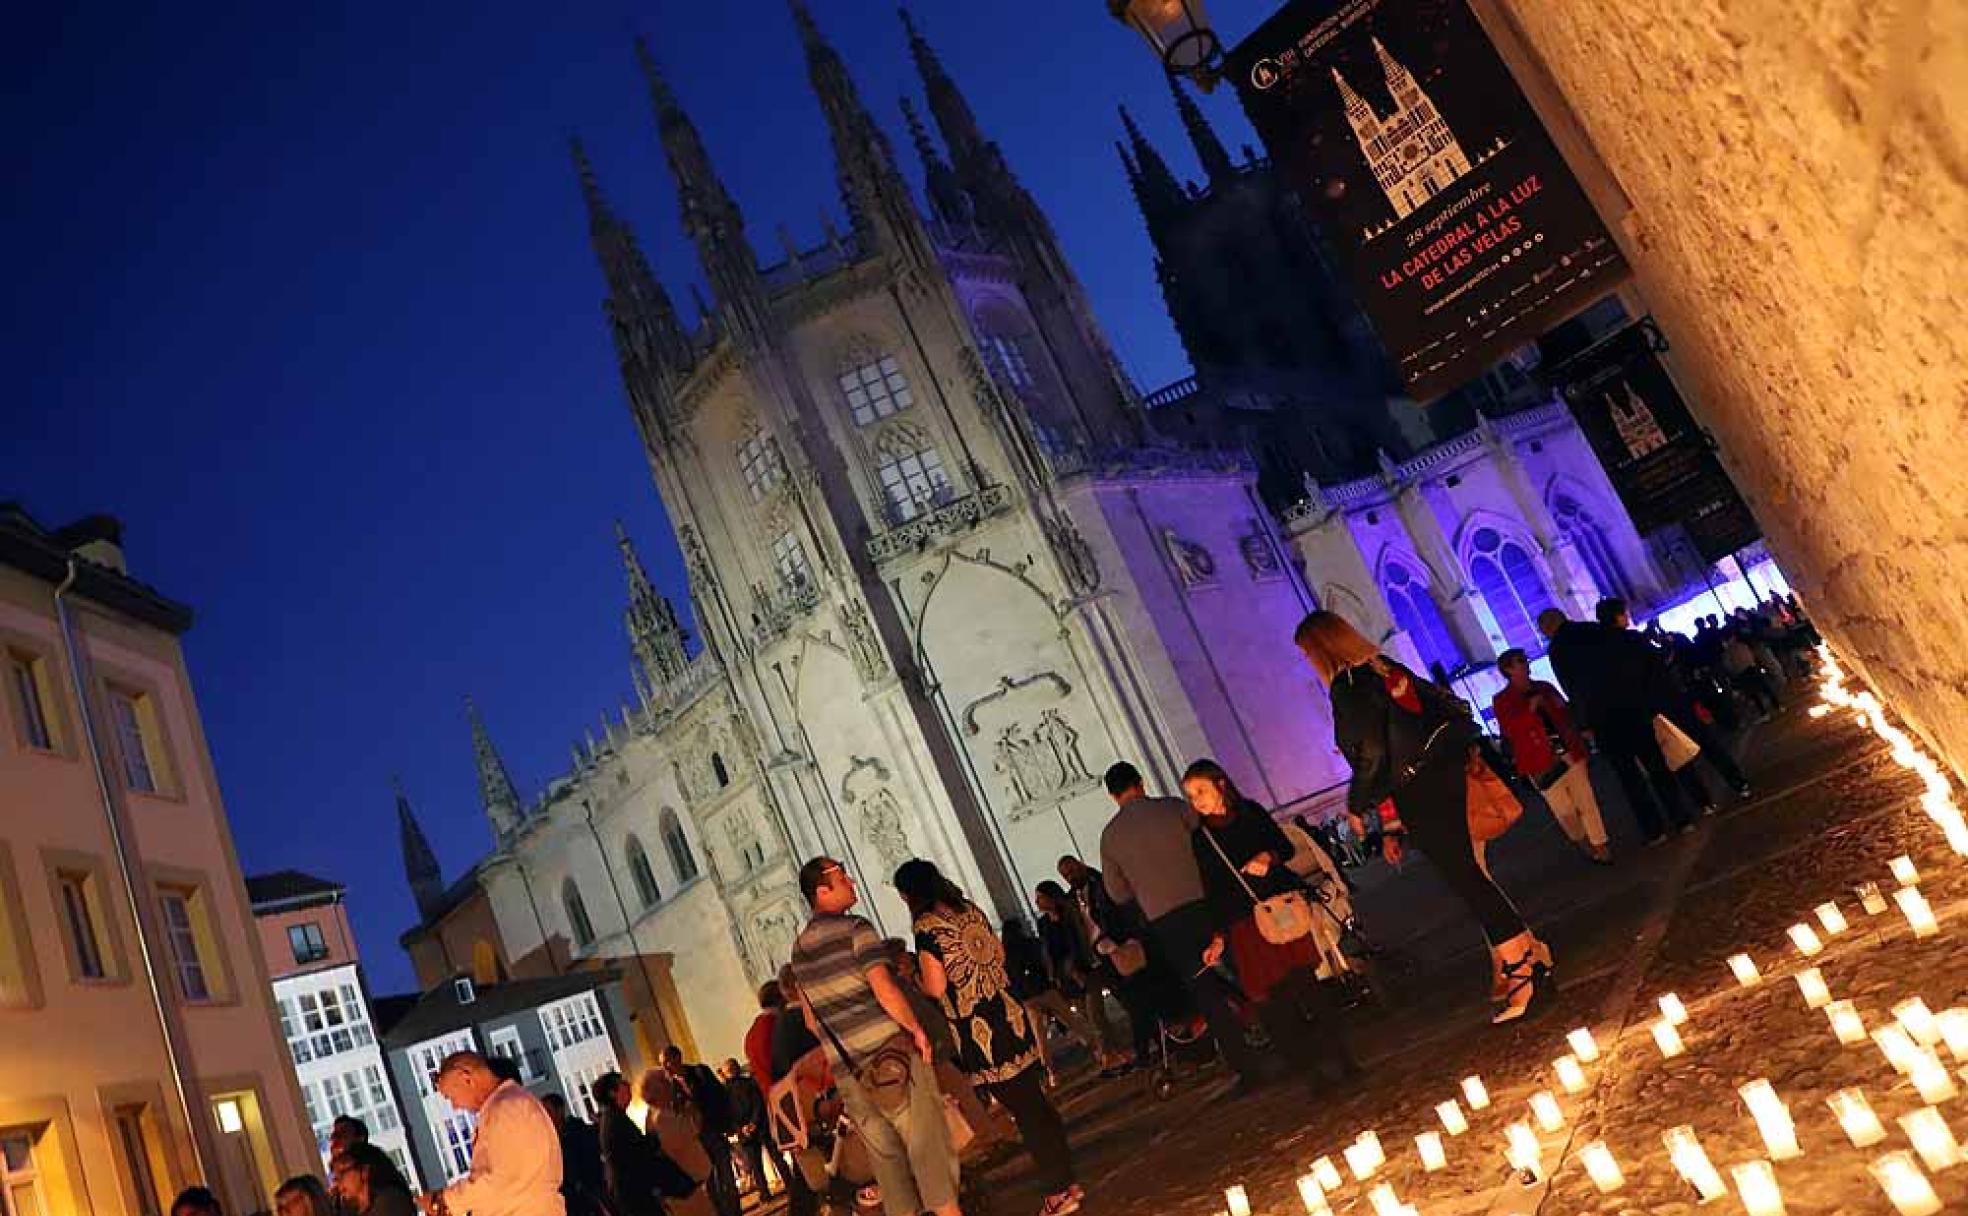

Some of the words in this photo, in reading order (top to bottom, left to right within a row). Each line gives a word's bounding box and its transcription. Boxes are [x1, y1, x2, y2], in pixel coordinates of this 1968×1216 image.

[1381, 269, 1403, 290] LA
[1402, 222, 1476, 277] CATEDRAL
[1476, 211, 1490, 229] A
[1488, 197, 1511, 218] LA
[1510, 174, 1542, 205] LUZ
[1406, 230, 1424, 248] 28
[1425, 183, 1492, 232] septiembre
[1421, 267, 1445, 290] DE
[1443, 247, 1474, 275] LAS
[1473, 215, 1522, 254] VELAS
